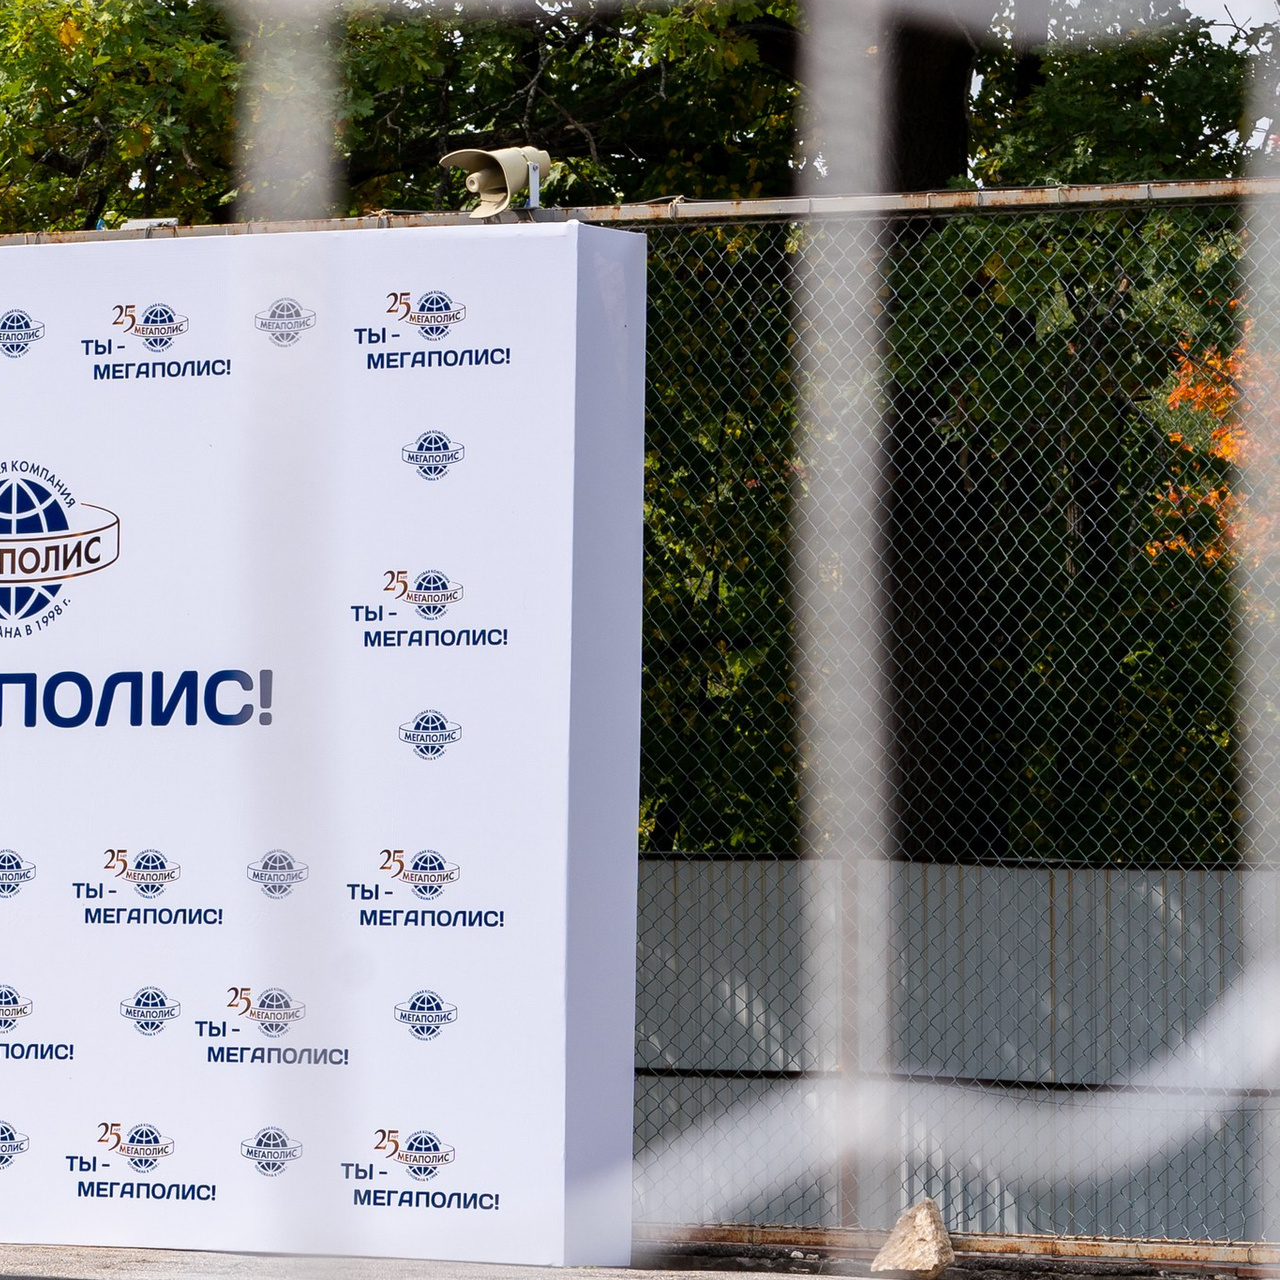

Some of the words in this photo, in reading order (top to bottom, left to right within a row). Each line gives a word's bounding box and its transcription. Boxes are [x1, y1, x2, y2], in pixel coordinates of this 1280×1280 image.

[386, 292, 410, 321] 25
[112, 304, 135, 332] 25
[259, 318, 311, 330] МЕГАПОЛИС
[409, 312, 460, 324] МЕГАПОЛИС
[134, 324, 183, 336] МЕГАПОЛИС
[354, 327, 386, 344] ТЫ
[81, 339, 112, 356] ТЫ
[367, 348, 510, 369] МЕГАПОЛИС!
[94, 359, 231, 380] МЕГАПОЛИС!
[407, 452, 459, 463] МЕГАПОЛИС
[11, 461, 76, 508] КОМПАНИЯ
[383, 570, 407, 599] 25
[406, 592, 458, 603] МЕГАПОЛИС
[25, 625, 33, 636] В
[36, 604, 63, 631] 1998
[351, 605, 383, 622] ТЫ
[364, 629, 507, 647] МЕГАПОЛИС!
[403, 732, 456, 742] МЕГАПОЛИС
[104, 849, 127, 877] 25
[379, 850, 404, 878] 25
[126, 871, 175, 882] МЕГАПОЛИС
[251, 871, 303, 882] МЕГАПОЛИС
[402, 872, 454, 883] МЕГАПОЛИС
[72, 883, 103, 899] ТЫ
[347, 884, 379, 900] ТЫ
[85, 908, 223, 925] МЕГАПОЛИС!
[360, 910, 504, 927] МЕГАПОЛИС!
[227, 987, 250, 1015] 25
[125, 1008, 175, 1018] МЕГАПОЛИС
[249, 1009, 300, 1021] МЕГАПОЛИС
[399, 1013, 452, 1023] МЕГАПОЛИС
[195, 1021, 227, 1037] ТЫ
[208, 1046, 348, 1065] МЕГАПОЛИС!
[97, 1123, 121, 1151] 25
[374, 1129, 399, 1158] 25
[119, 1145, 169, 1156] МЕГАПОЛИС
[245, 1149, 297, 1159] МЕГАПОЛИС
[397, 1152, 449, 1164] МЕГАПОЛИС
[66, 1156, 97, 1172] ТЫ
[341, 1163, 374, 1179] ТЫ
[78, 1181, 216, 1201] МЕГАПОЛИС!
[354, 1189, 499, 1210] МЕГАПОЛИС!
